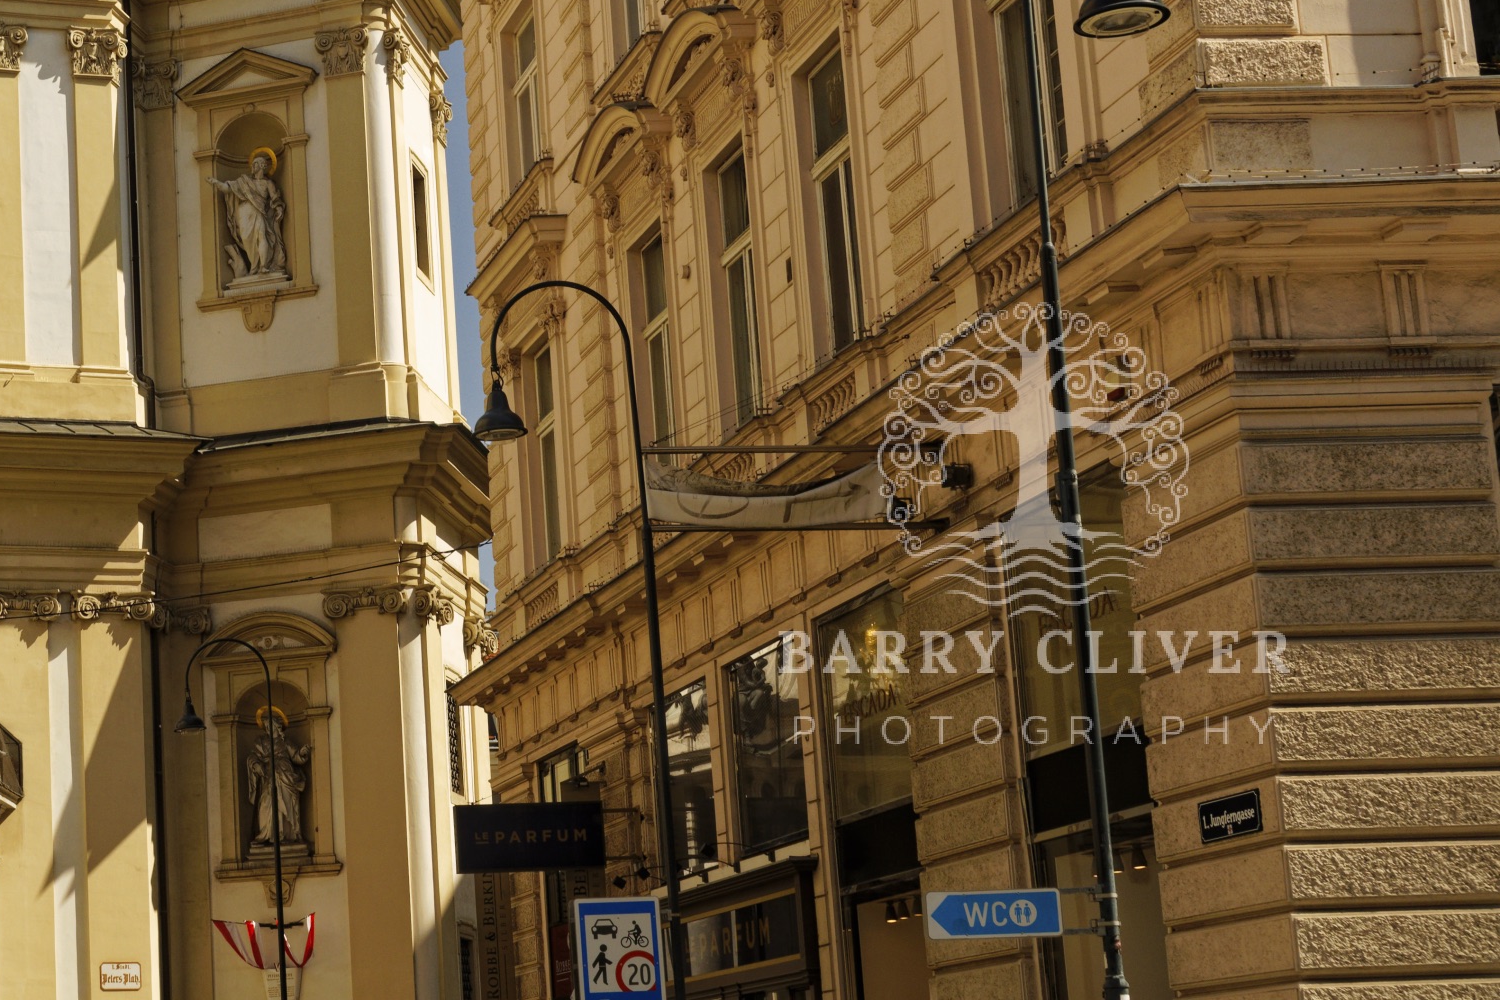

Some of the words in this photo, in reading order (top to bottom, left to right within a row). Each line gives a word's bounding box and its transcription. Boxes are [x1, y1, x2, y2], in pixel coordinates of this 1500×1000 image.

[1202, 815, 1210, 829] 1.
[1209, 807, 1256, 829] Jungferngasse
[495, 828, 587, 844] PARFUM
[963, 901, 1008, 927] WC
[485, 931, 496, 942] &
[487, 947, 499, 999] ROBBE
[627, 963, 651, 986] 20
